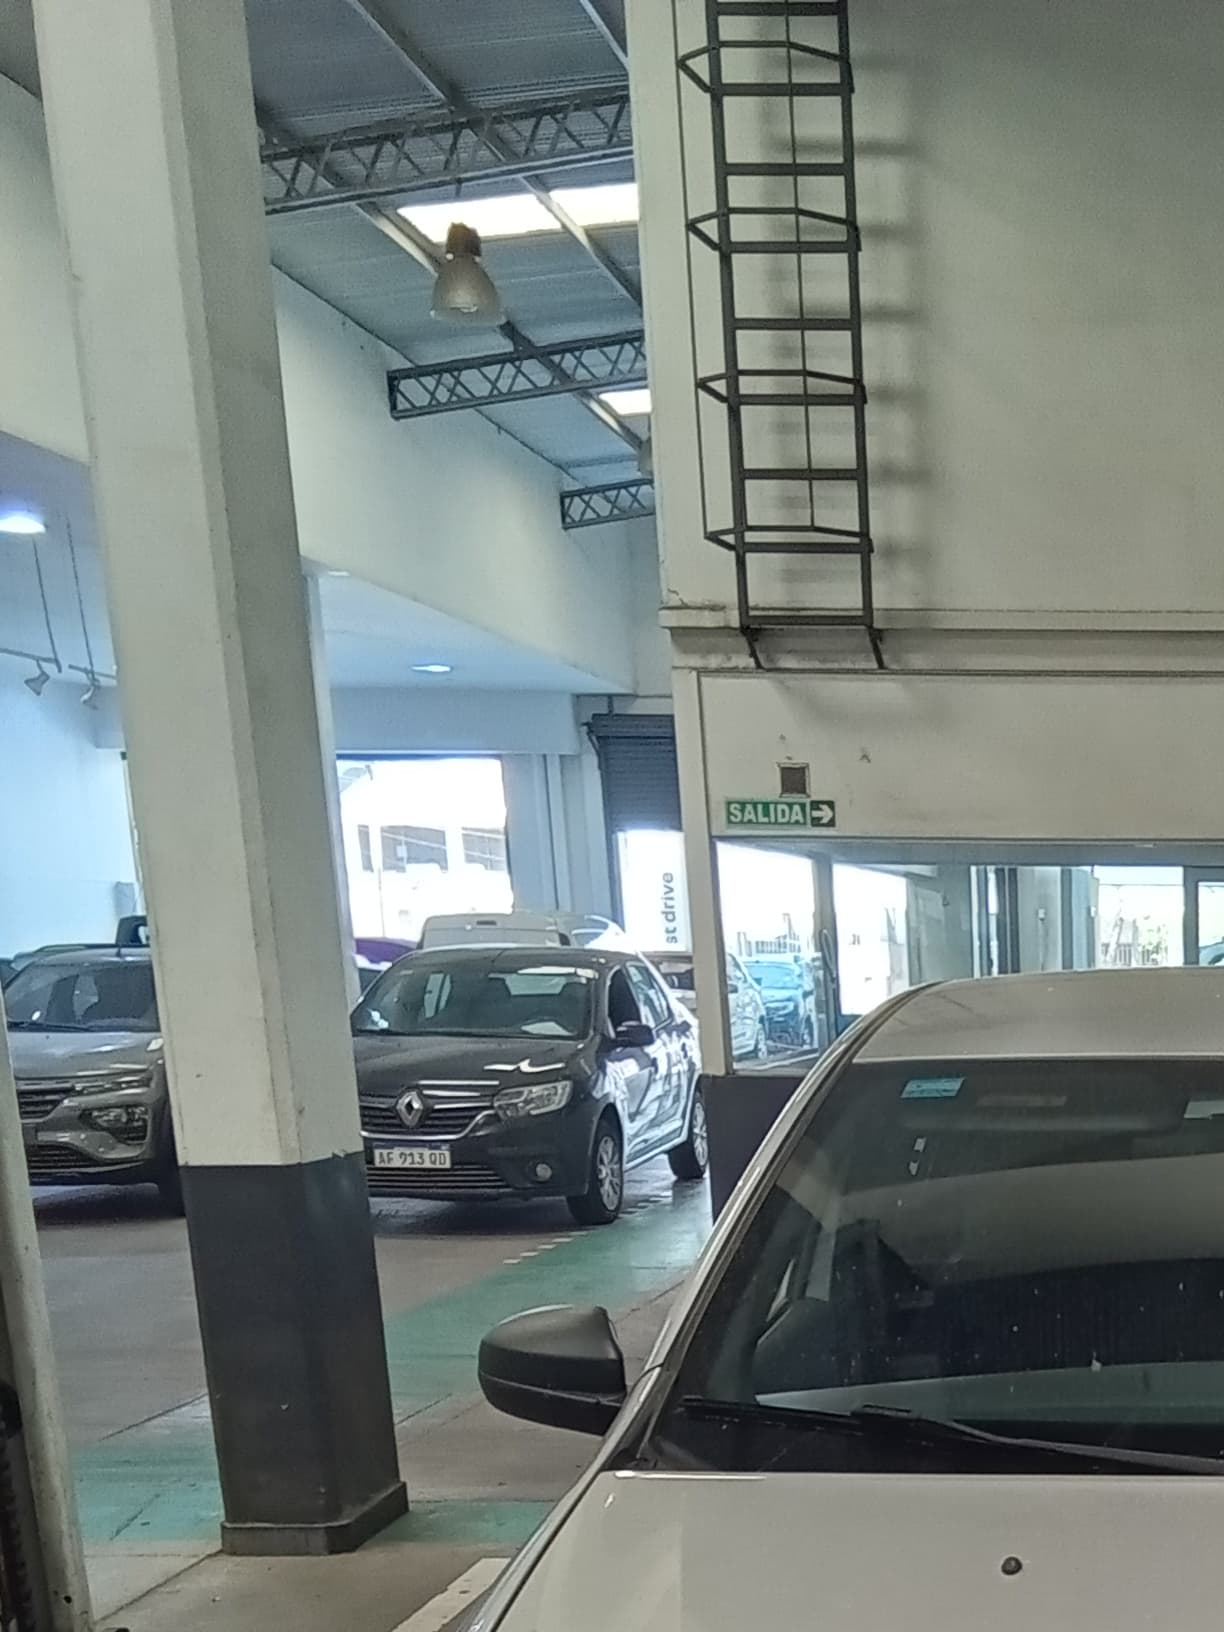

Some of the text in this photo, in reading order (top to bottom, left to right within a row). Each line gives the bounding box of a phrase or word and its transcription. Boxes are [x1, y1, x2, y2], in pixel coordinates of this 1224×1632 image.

[728, 803, 804, 823] SALIDA
[660, 872, 676, 923] drive
[378, 1152, 393, 1165] AF
[400, 1152, 425, 1166] 913
